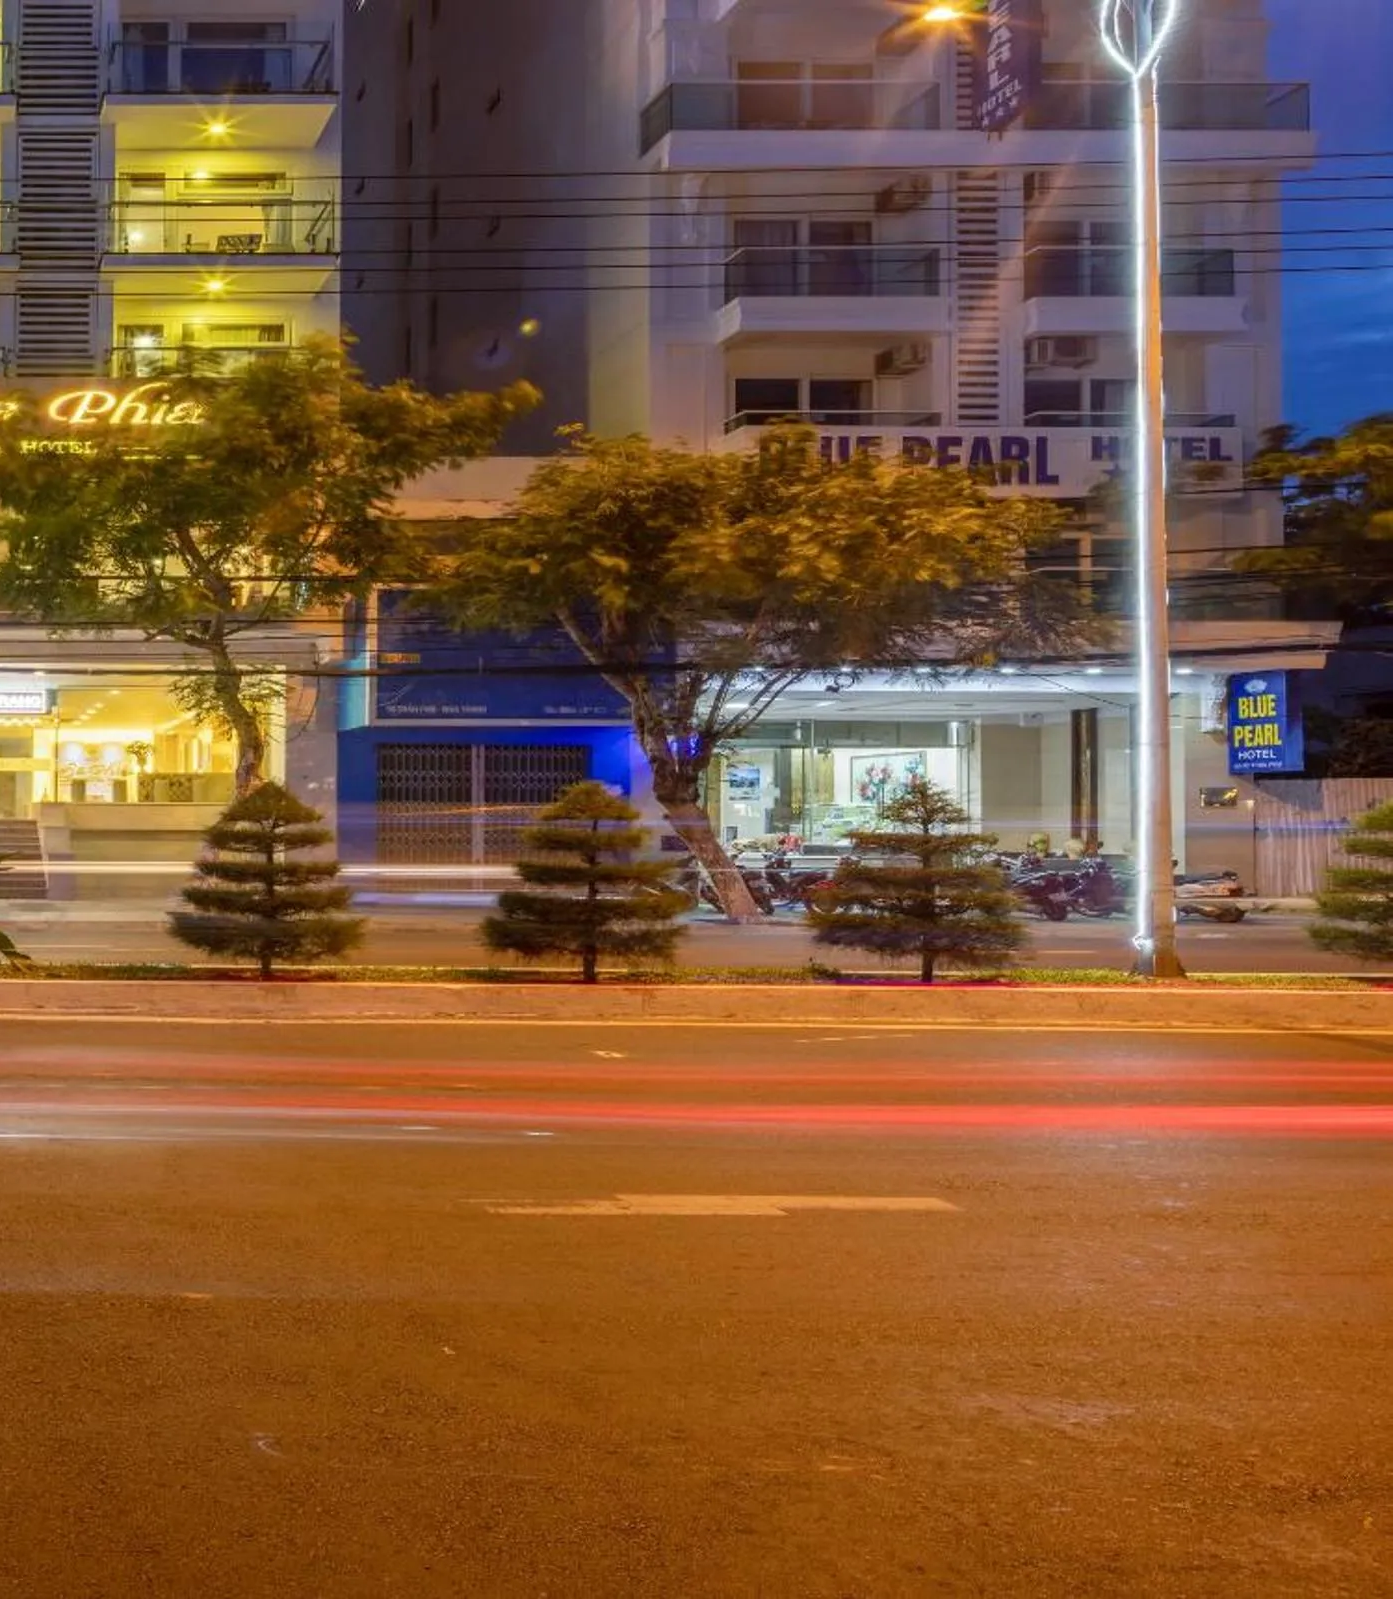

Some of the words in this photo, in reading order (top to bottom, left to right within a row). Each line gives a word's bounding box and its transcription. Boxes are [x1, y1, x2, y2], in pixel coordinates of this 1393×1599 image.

[20, 439, 98, 455] HOTEL
[1091, 435, 1234, 461] HTEL
[1238, 694, 1277, 719] BLUE
[1234, 723, 1282, 748] PEARL
[1238, 749, 1277, 760] HOTEL
